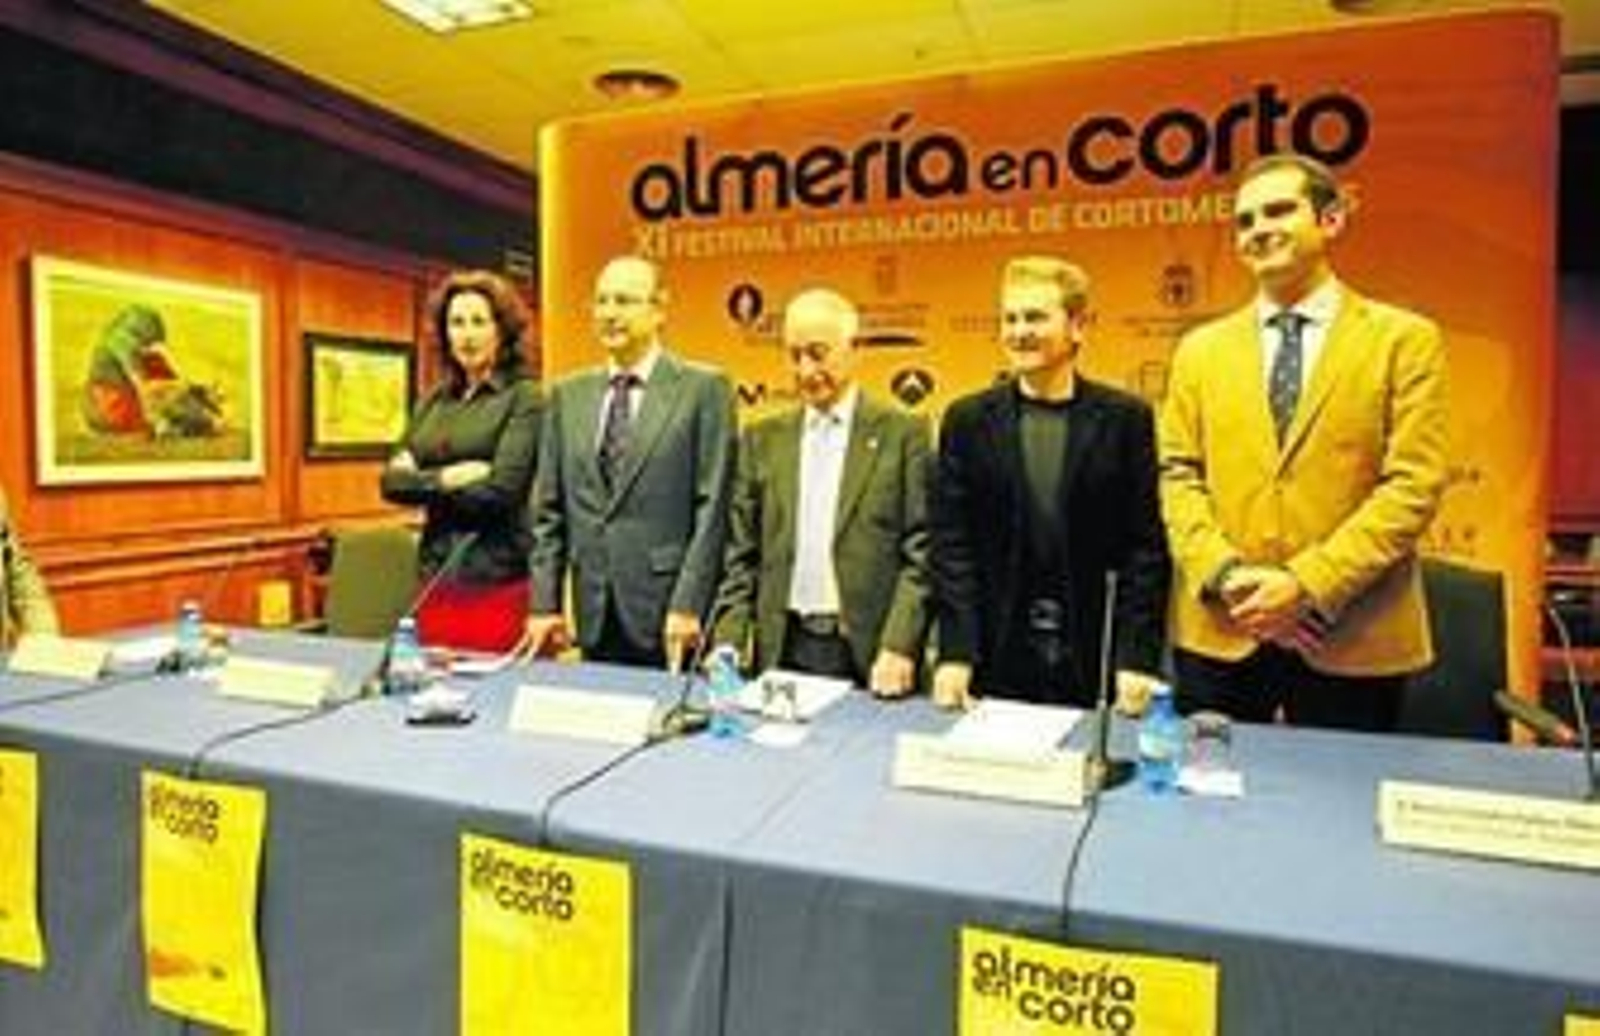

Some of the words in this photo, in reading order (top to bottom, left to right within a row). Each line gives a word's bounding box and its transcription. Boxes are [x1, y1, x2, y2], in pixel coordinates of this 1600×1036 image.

[631, 112, 969, 222] almería
[981, 149, 1058, 192] en
[1067, 84, 1370, 184] corto
[634, 225, 668, 262] XI
[671, 222, 788, 258] FESTIVAL
[797, 208, 1021, 251] INTERNACIONAL
[1028, 206, 1065, 234] DE
[470, 849, 573, 895] almería
[495, 885, 573, 921] corto
[972, 948, 1136, 1001] almería
[1018, 991, 1136, 1032] corto
